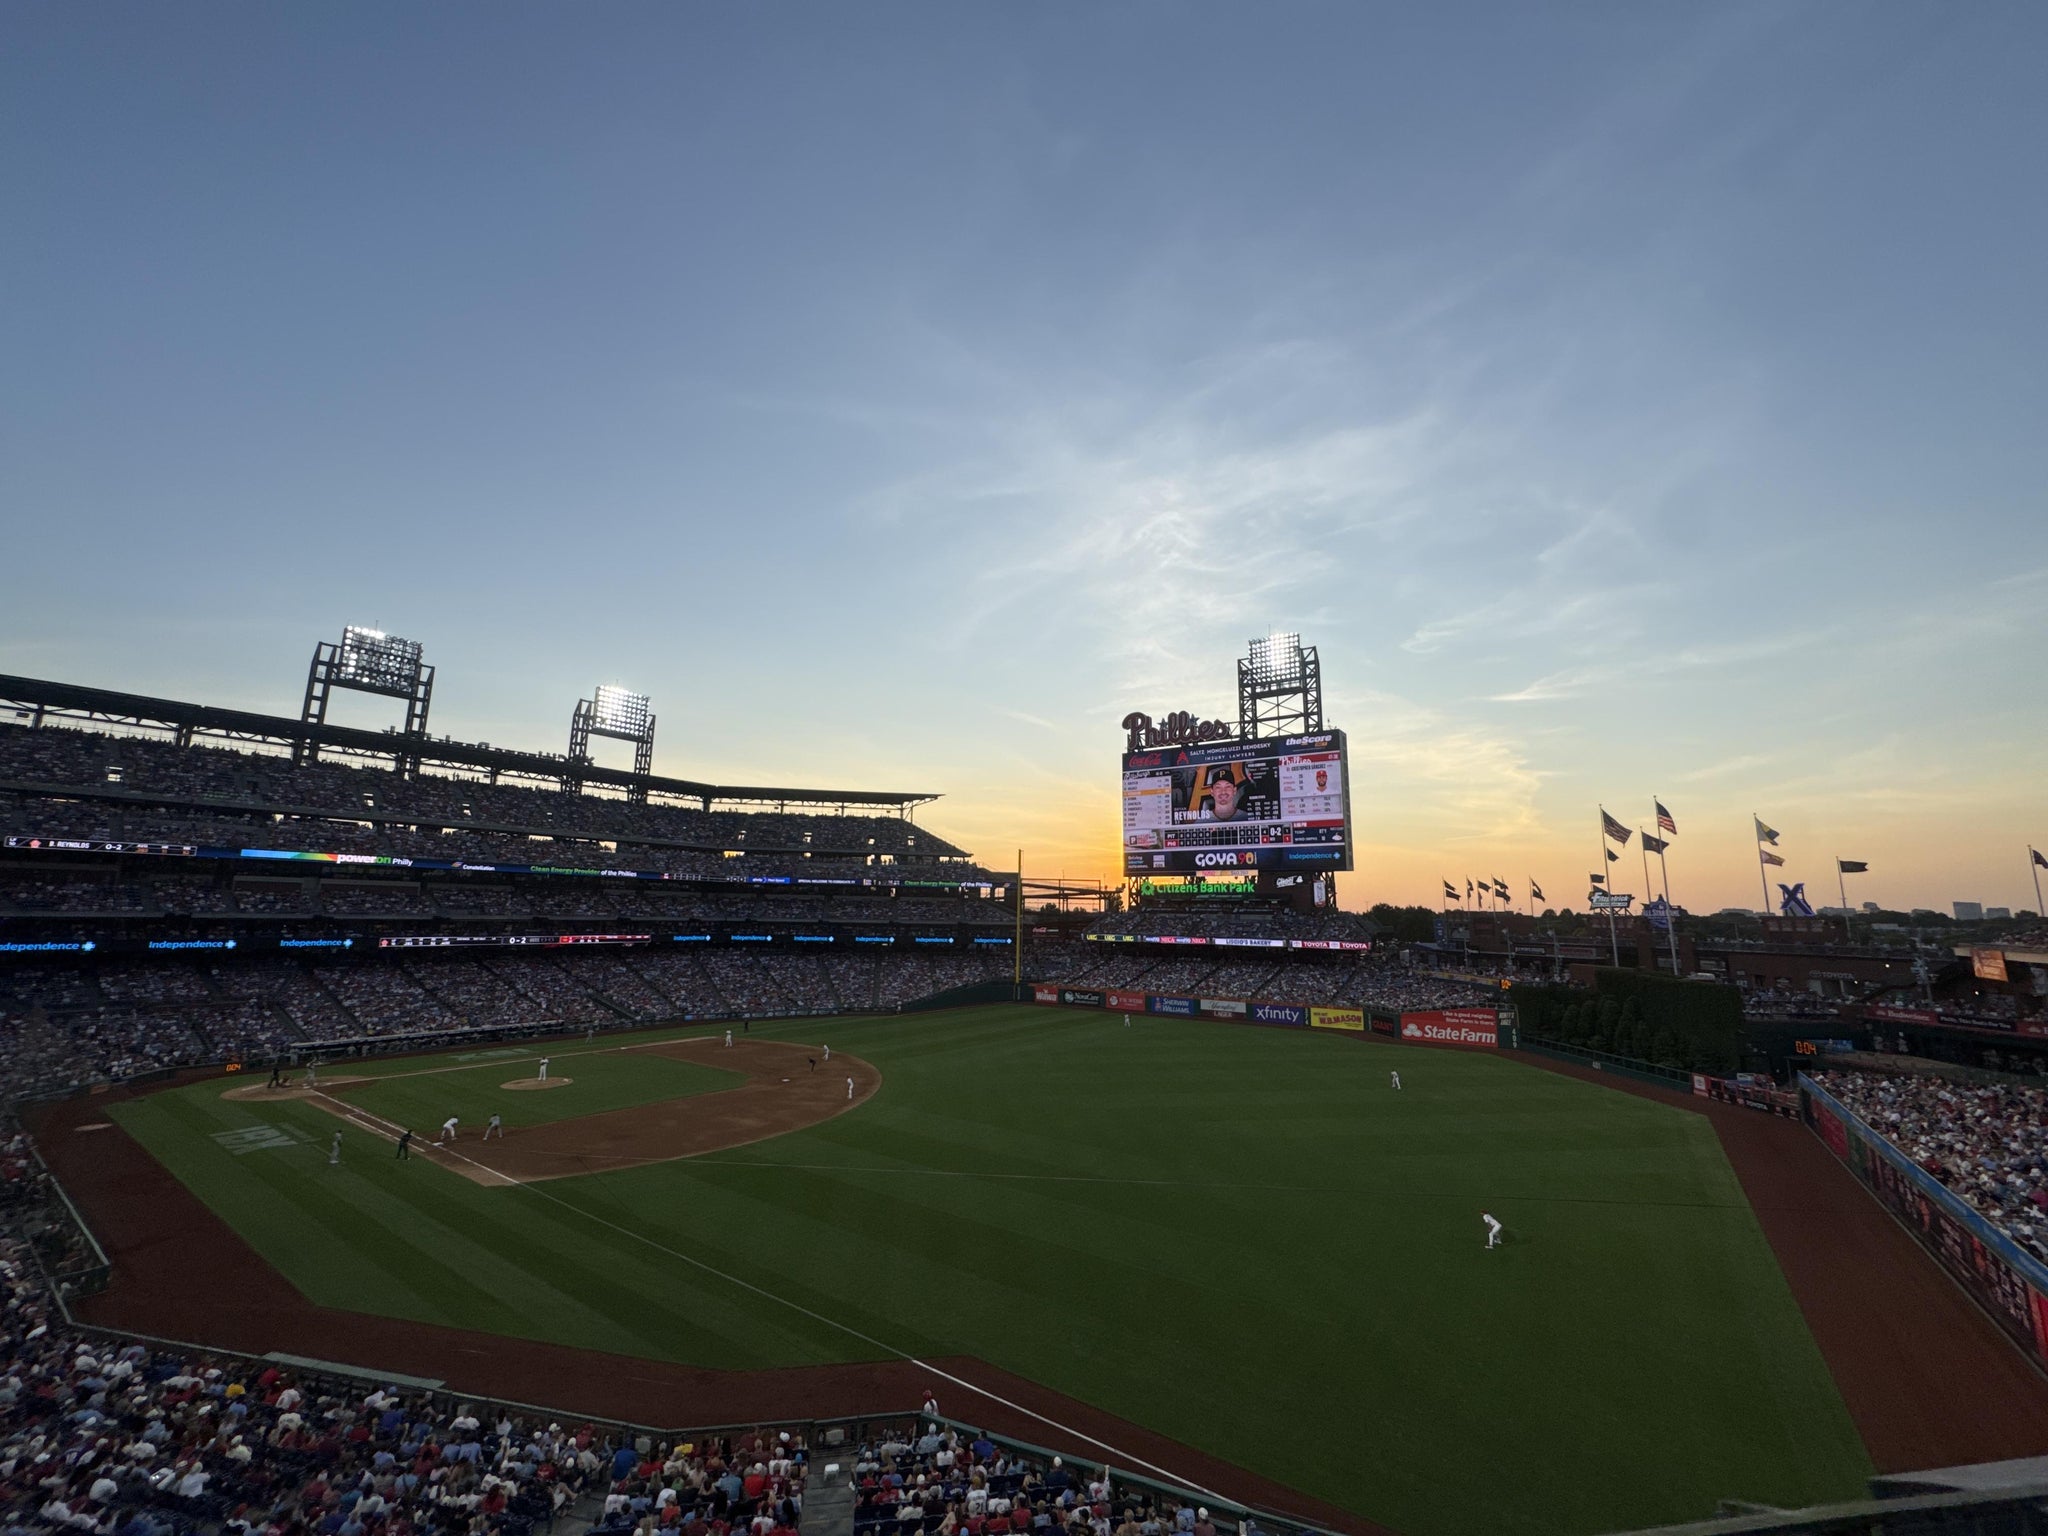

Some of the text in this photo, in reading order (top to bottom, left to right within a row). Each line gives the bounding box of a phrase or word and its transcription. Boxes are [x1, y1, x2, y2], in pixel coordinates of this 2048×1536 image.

[1122, 711, 1229, 749] Phillies
[1286, 735, 1332, 746] theScore
[1174, 810, 1211, 821] REYNOLDS
[1270, 827, 1282, 836] 0-2
[392, 857, 413, 866] Philly
[1195, 852, 1237, 867] GOYA
[530, 865, 549, 873] Clean
[550, 866, 571, 875] Energy
[572, 867, 600, 876] Provider
[1156, 881, 1255, 893] Citizens Bank Park
[149, 940, 223, 950] Independence
[280, 938, 342, 948] Independence
[1162, 998, 1189, 1006] SHERWIN
[1255, 1005, 1300, 1024] xfinity
